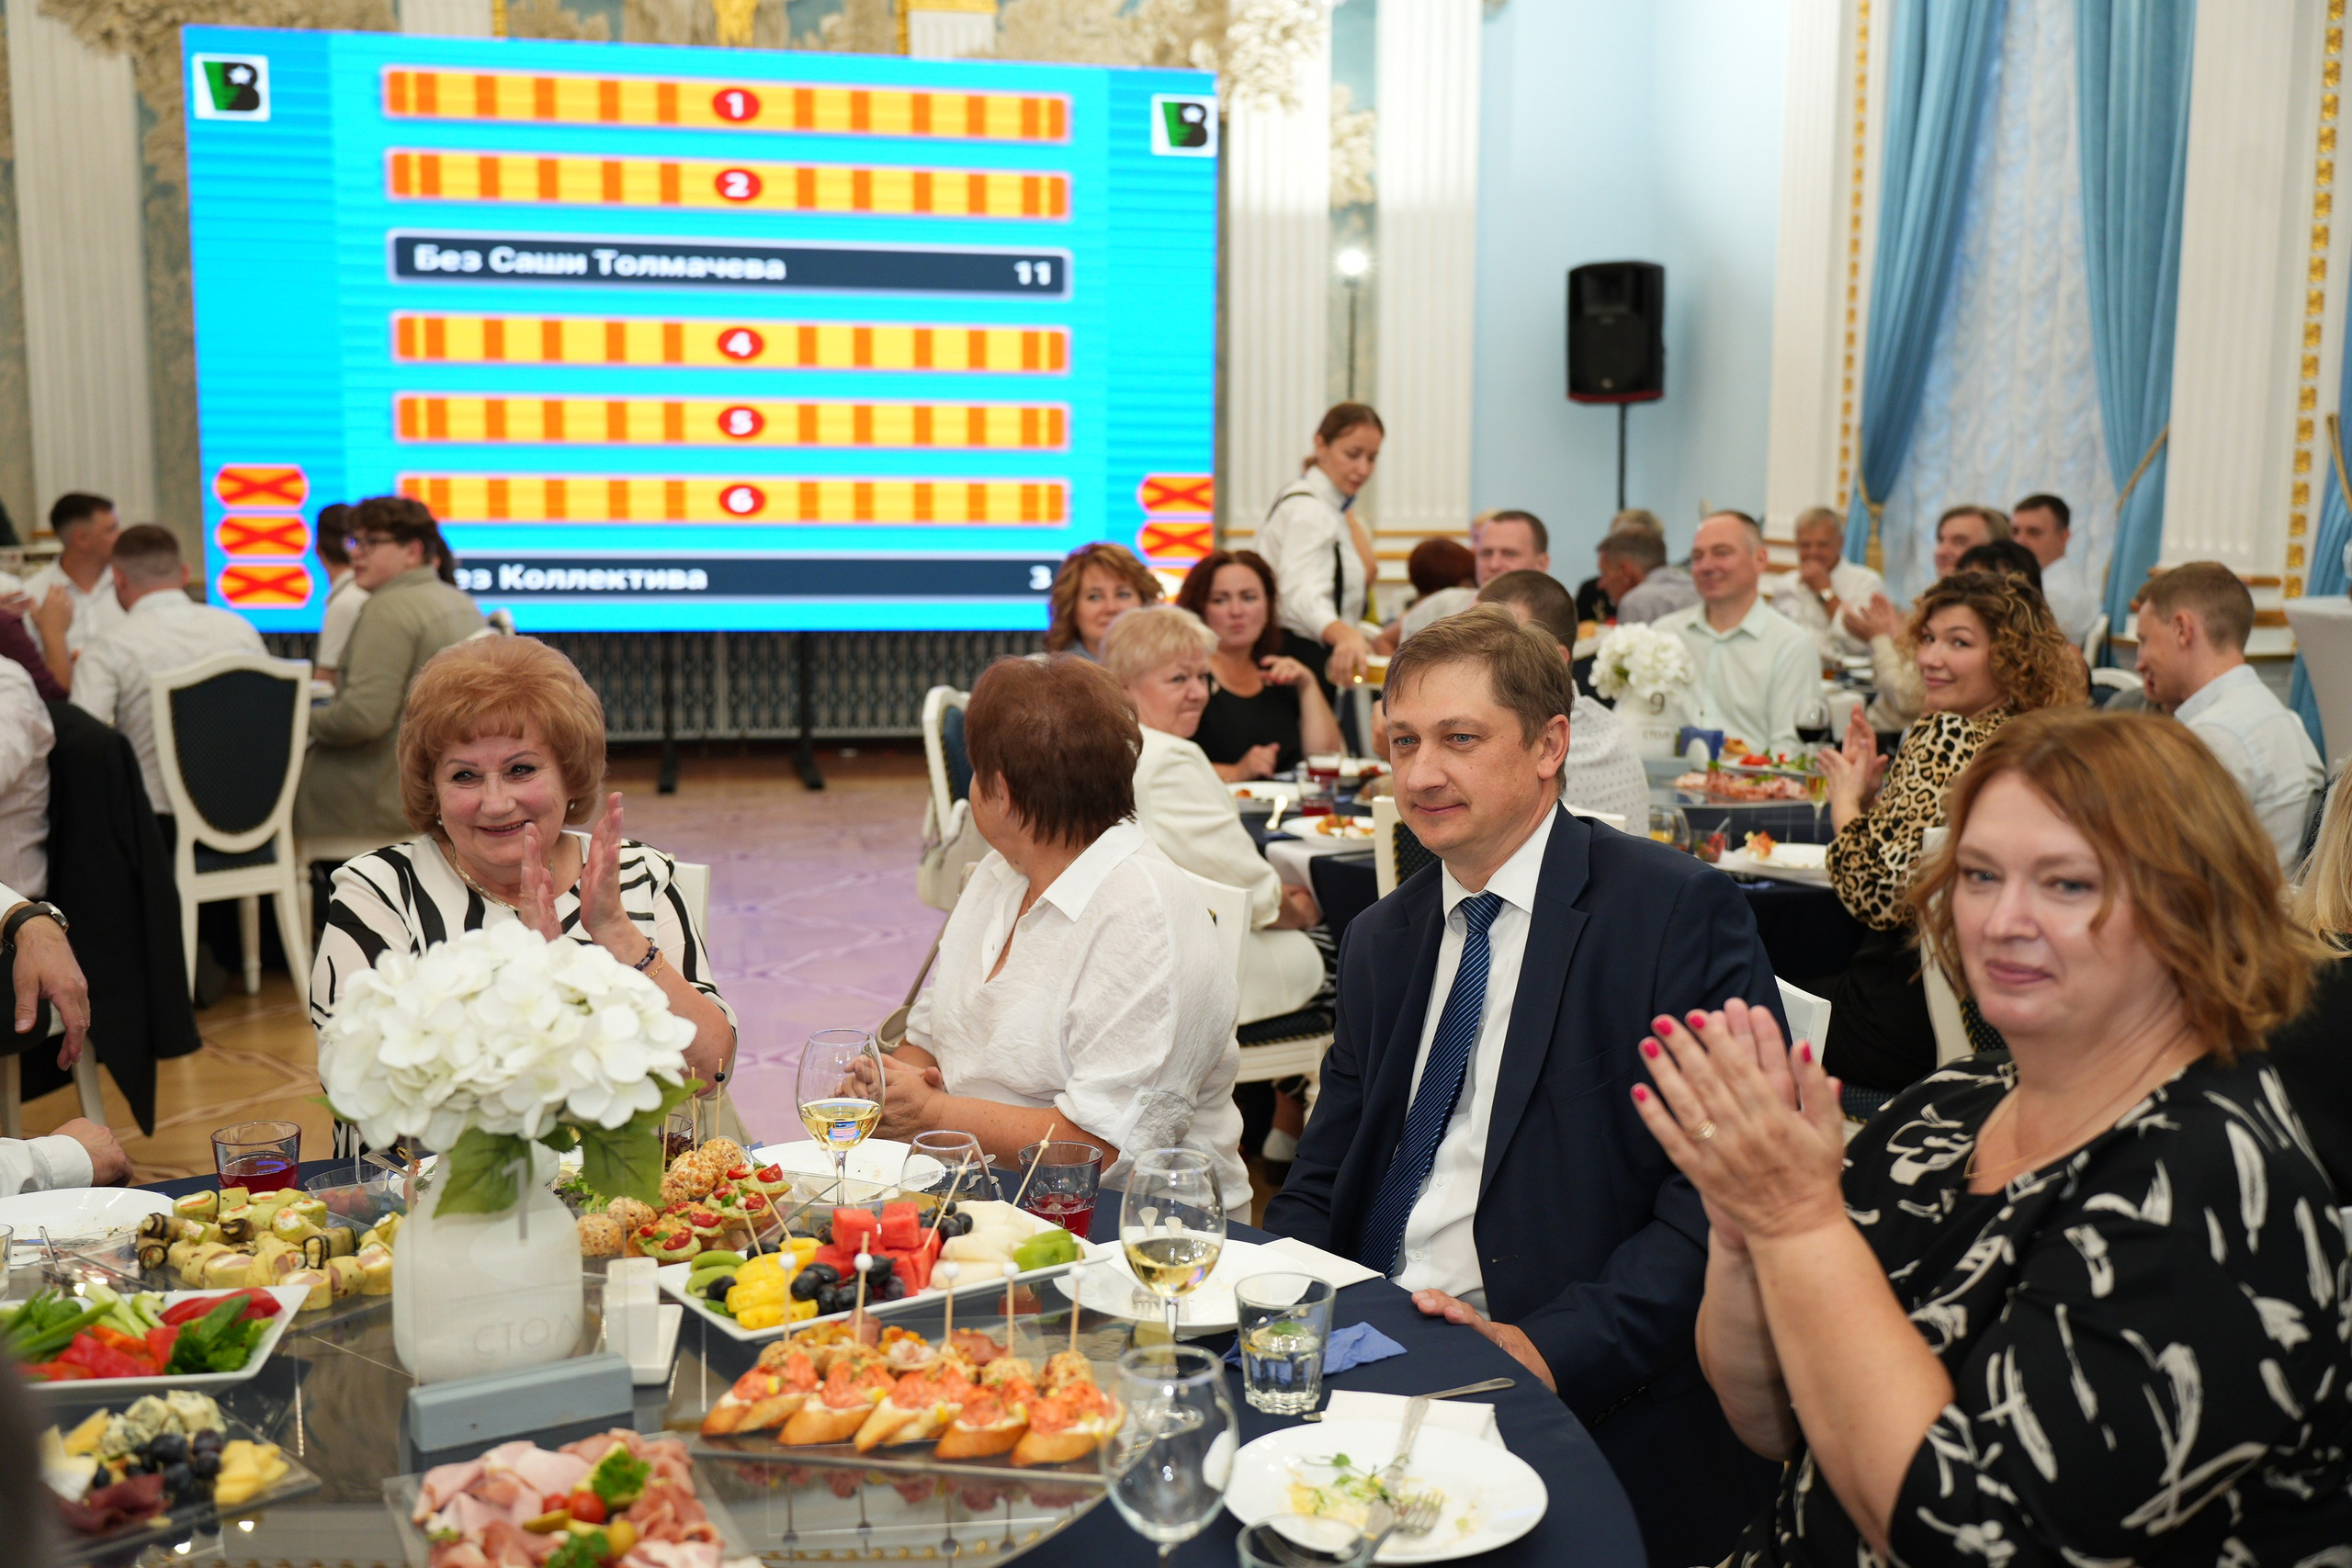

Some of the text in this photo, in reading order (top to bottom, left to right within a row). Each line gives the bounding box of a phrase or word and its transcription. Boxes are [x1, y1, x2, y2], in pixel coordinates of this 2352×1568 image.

[725, 91, 744, 118] 1
[724, 172, 750, 197] 2
[413, 243, 1052, 287] Без Саши Толмачева 11
[726, 332, 752, 356] 4
[729, 410, 753, 435] 5
[728, 488, 754, 513] 6
[453, 563, 1053, 591] ез Коллектива 3
[1649, 691, 1666, 716] 9
[501, 1157, 528, 1240] 1
